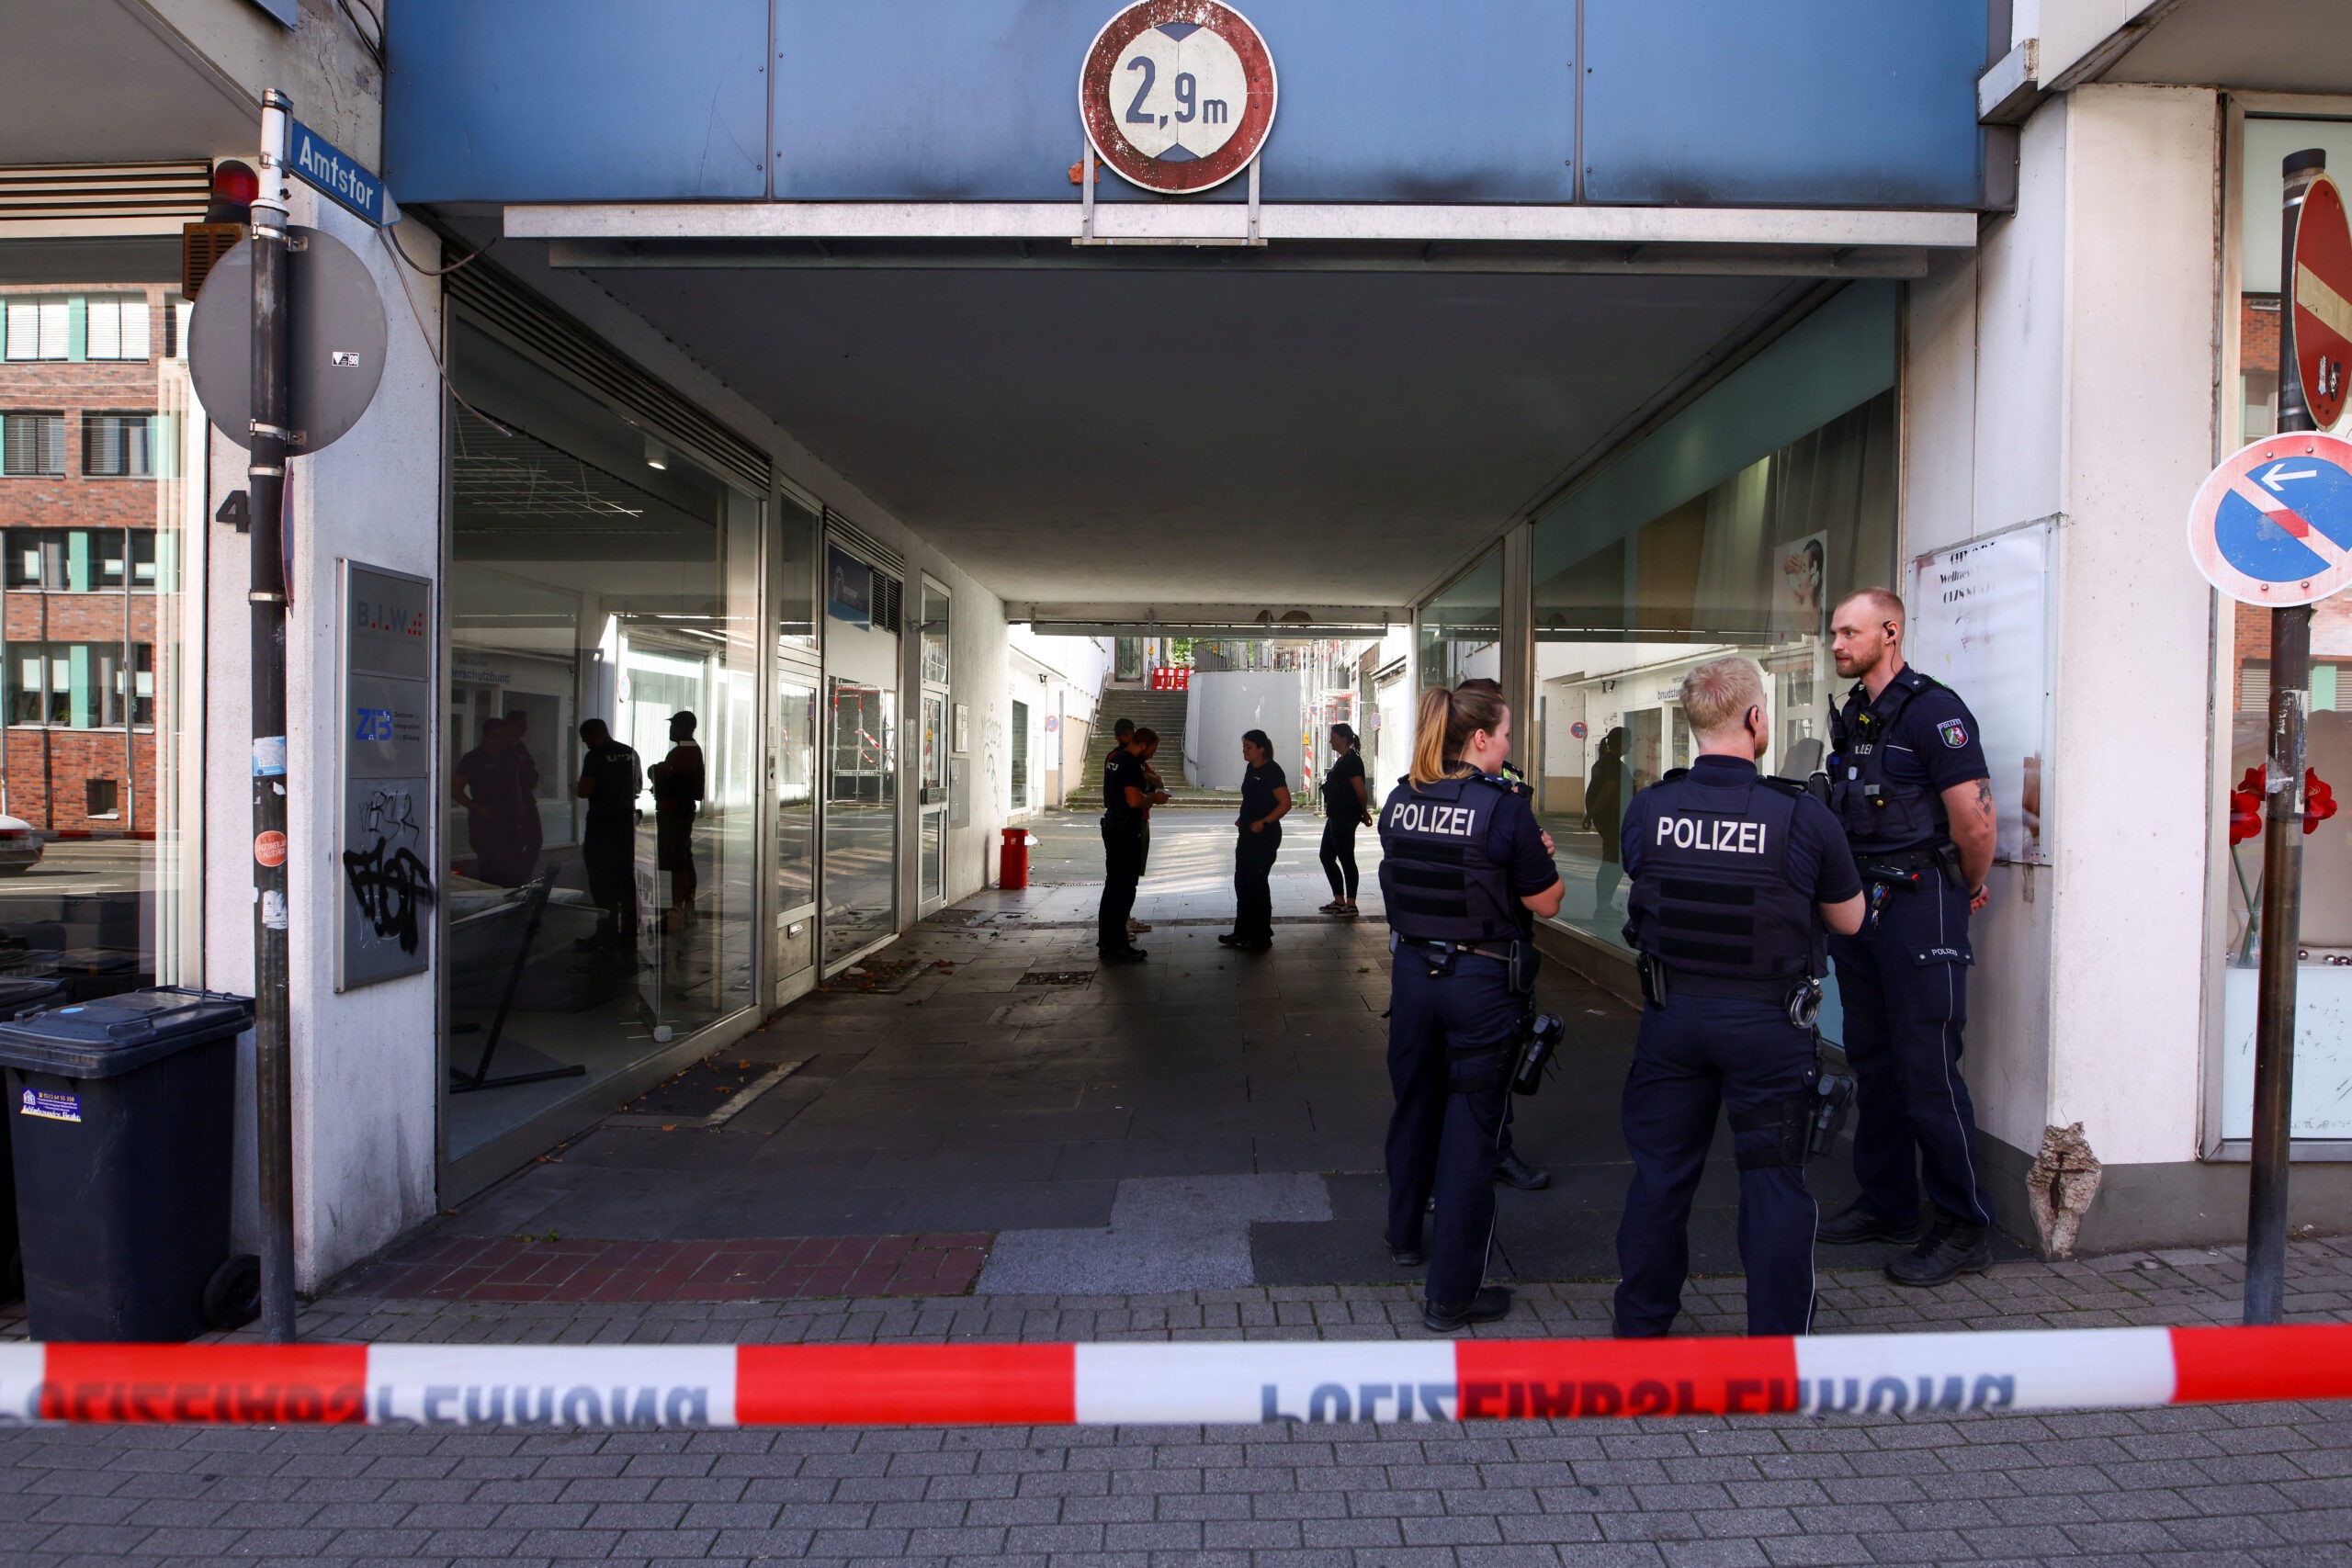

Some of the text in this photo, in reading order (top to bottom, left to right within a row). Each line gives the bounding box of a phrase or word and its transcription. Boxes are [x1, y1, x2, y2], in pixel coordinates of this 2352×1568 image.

[299, 135, 374, 210] Amtstor
[216, 490, 252, 533] 4
[1389, 803, 1476, 837] POLIZEI
[1657, 817, 1766, 854] POLIZEI
[1931, 948, 1958, 956] POLIZEI
